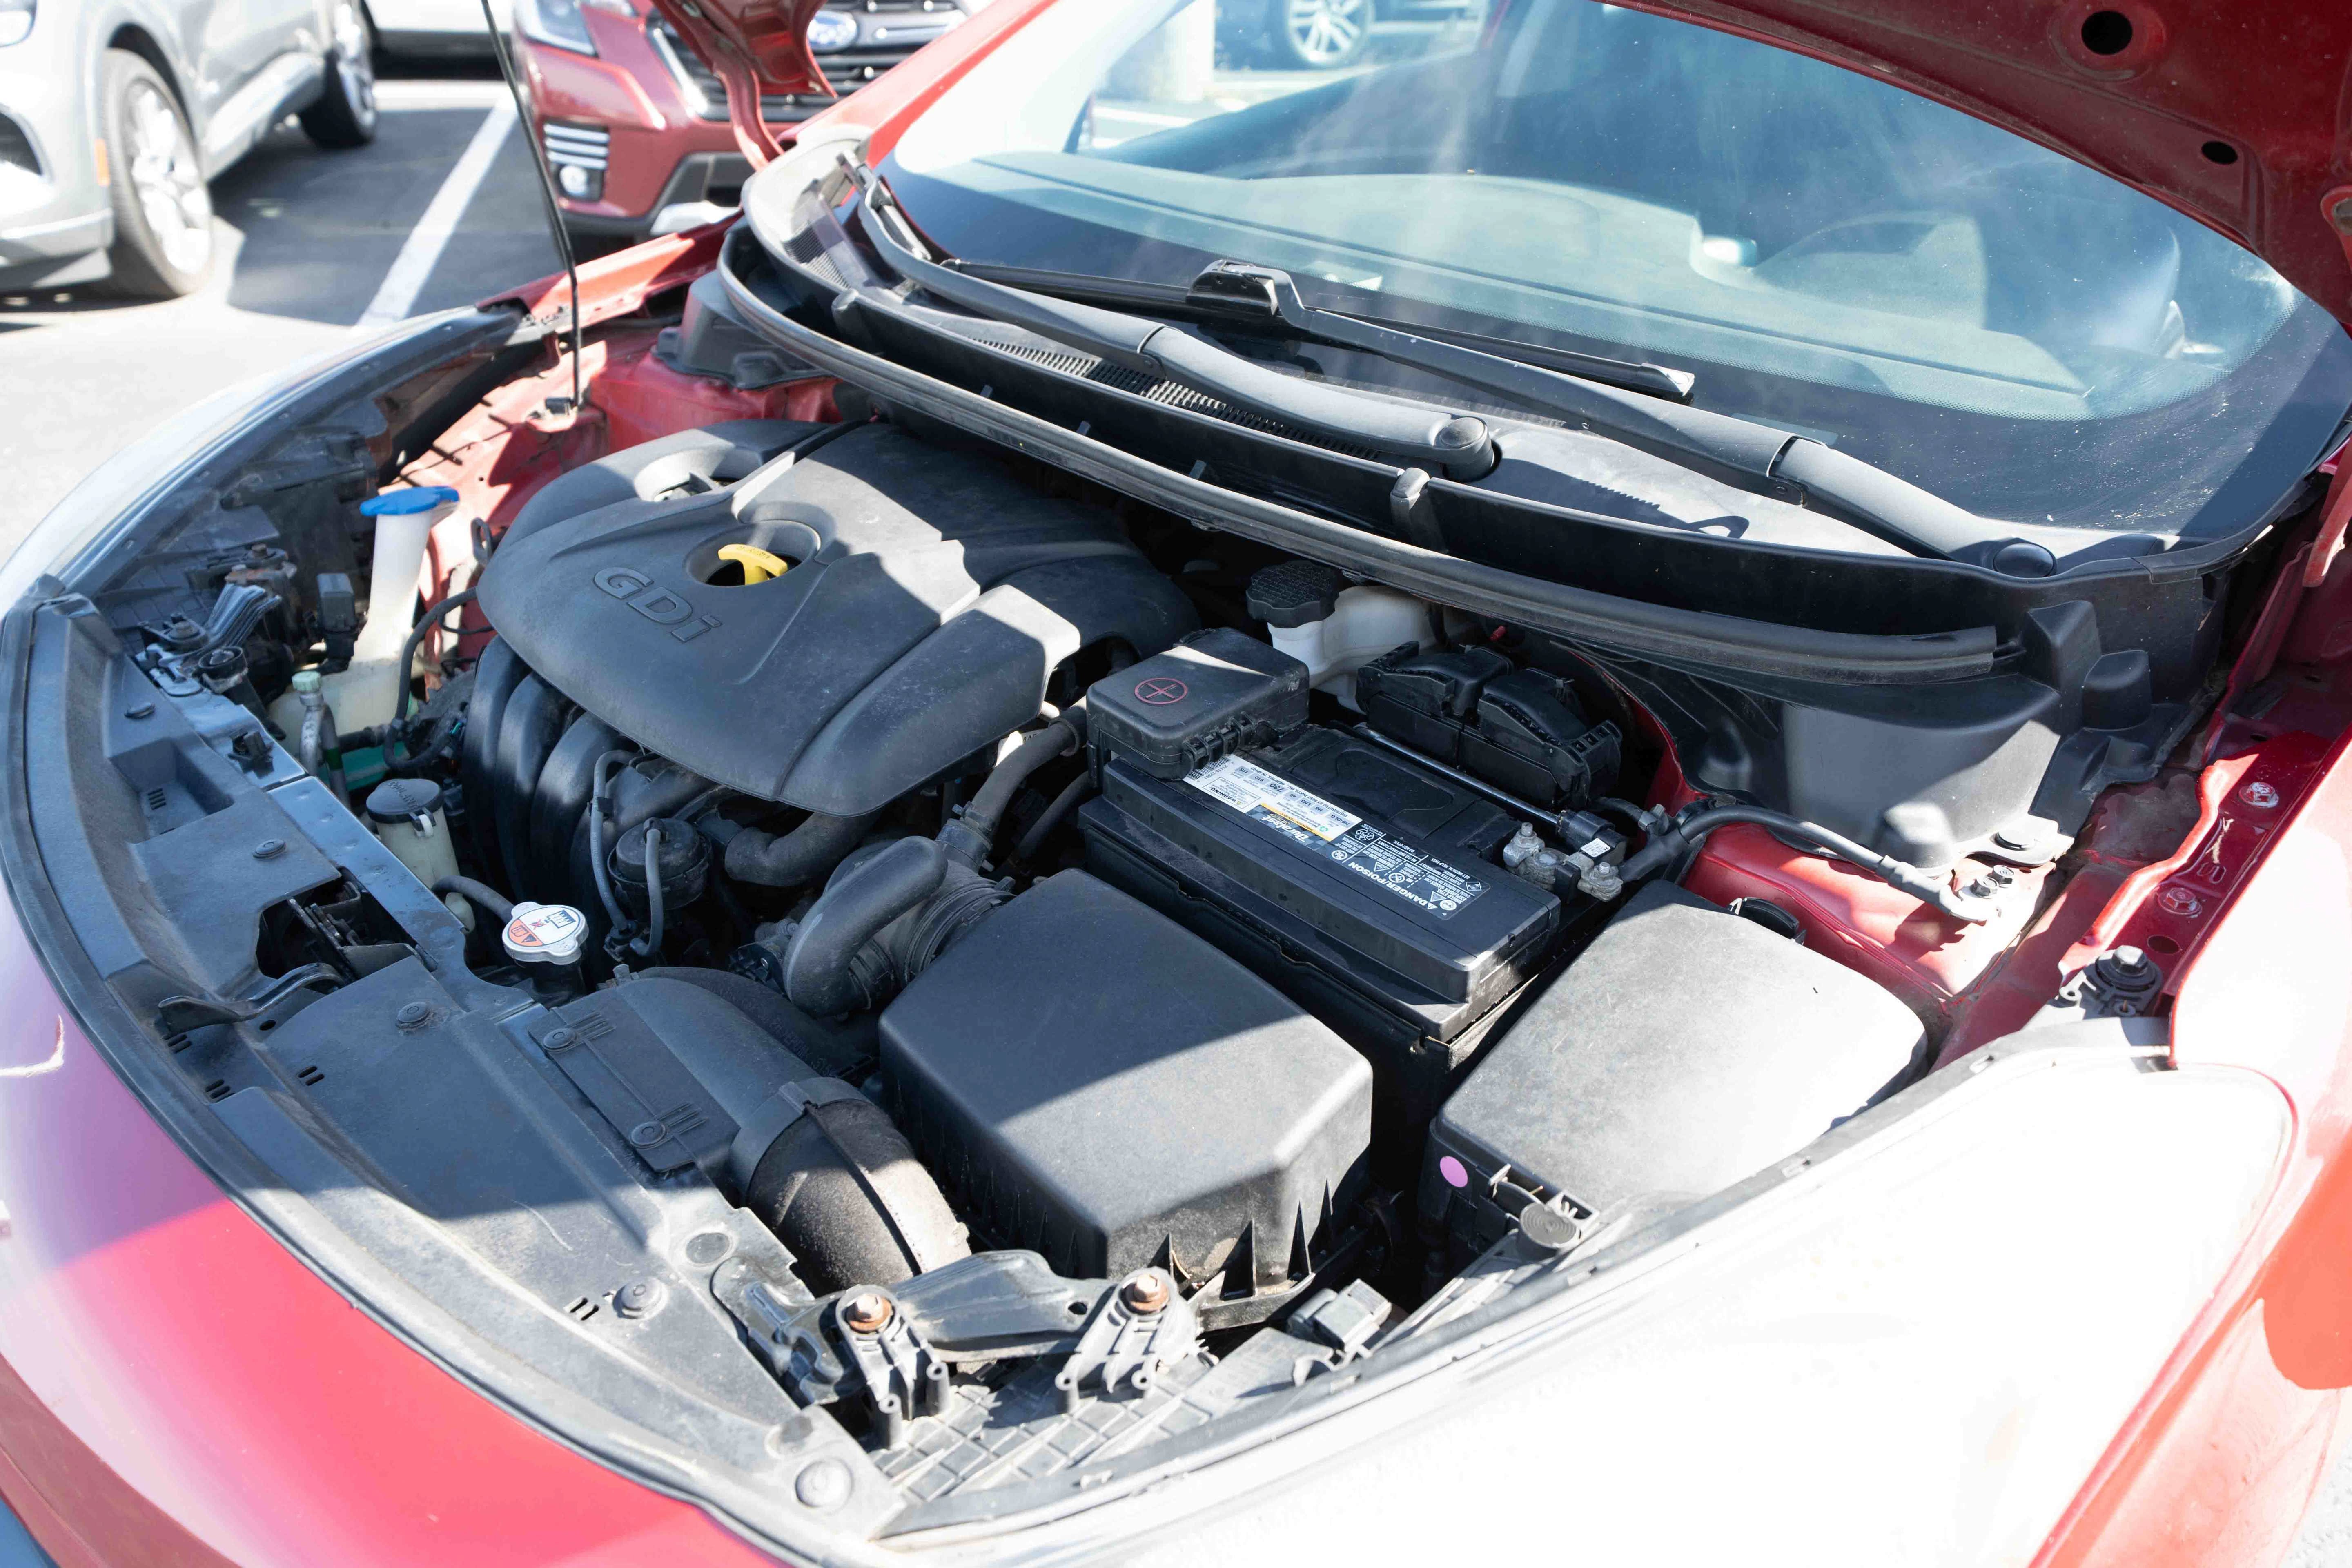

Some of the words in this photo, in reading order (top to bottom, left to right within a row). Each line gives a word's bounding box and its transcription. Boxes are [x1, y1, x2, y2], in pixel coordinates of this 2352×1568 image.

[1268, 782, 1285, 792] 730
[1207, 786, 1238, 802] WARNING:
[1322, 804, 1348, 817] DISTRIBUTED
[1329, 814, 1350, 826] H6-DLG
[1260, 814, 1311, 842] Duralast
[1447, 866, 1463, 875] MEDICAL
[1347, 861, 1429, 906] DANGER/POISON
[1442, 887, 1467, 901] EXPLOSIVE
